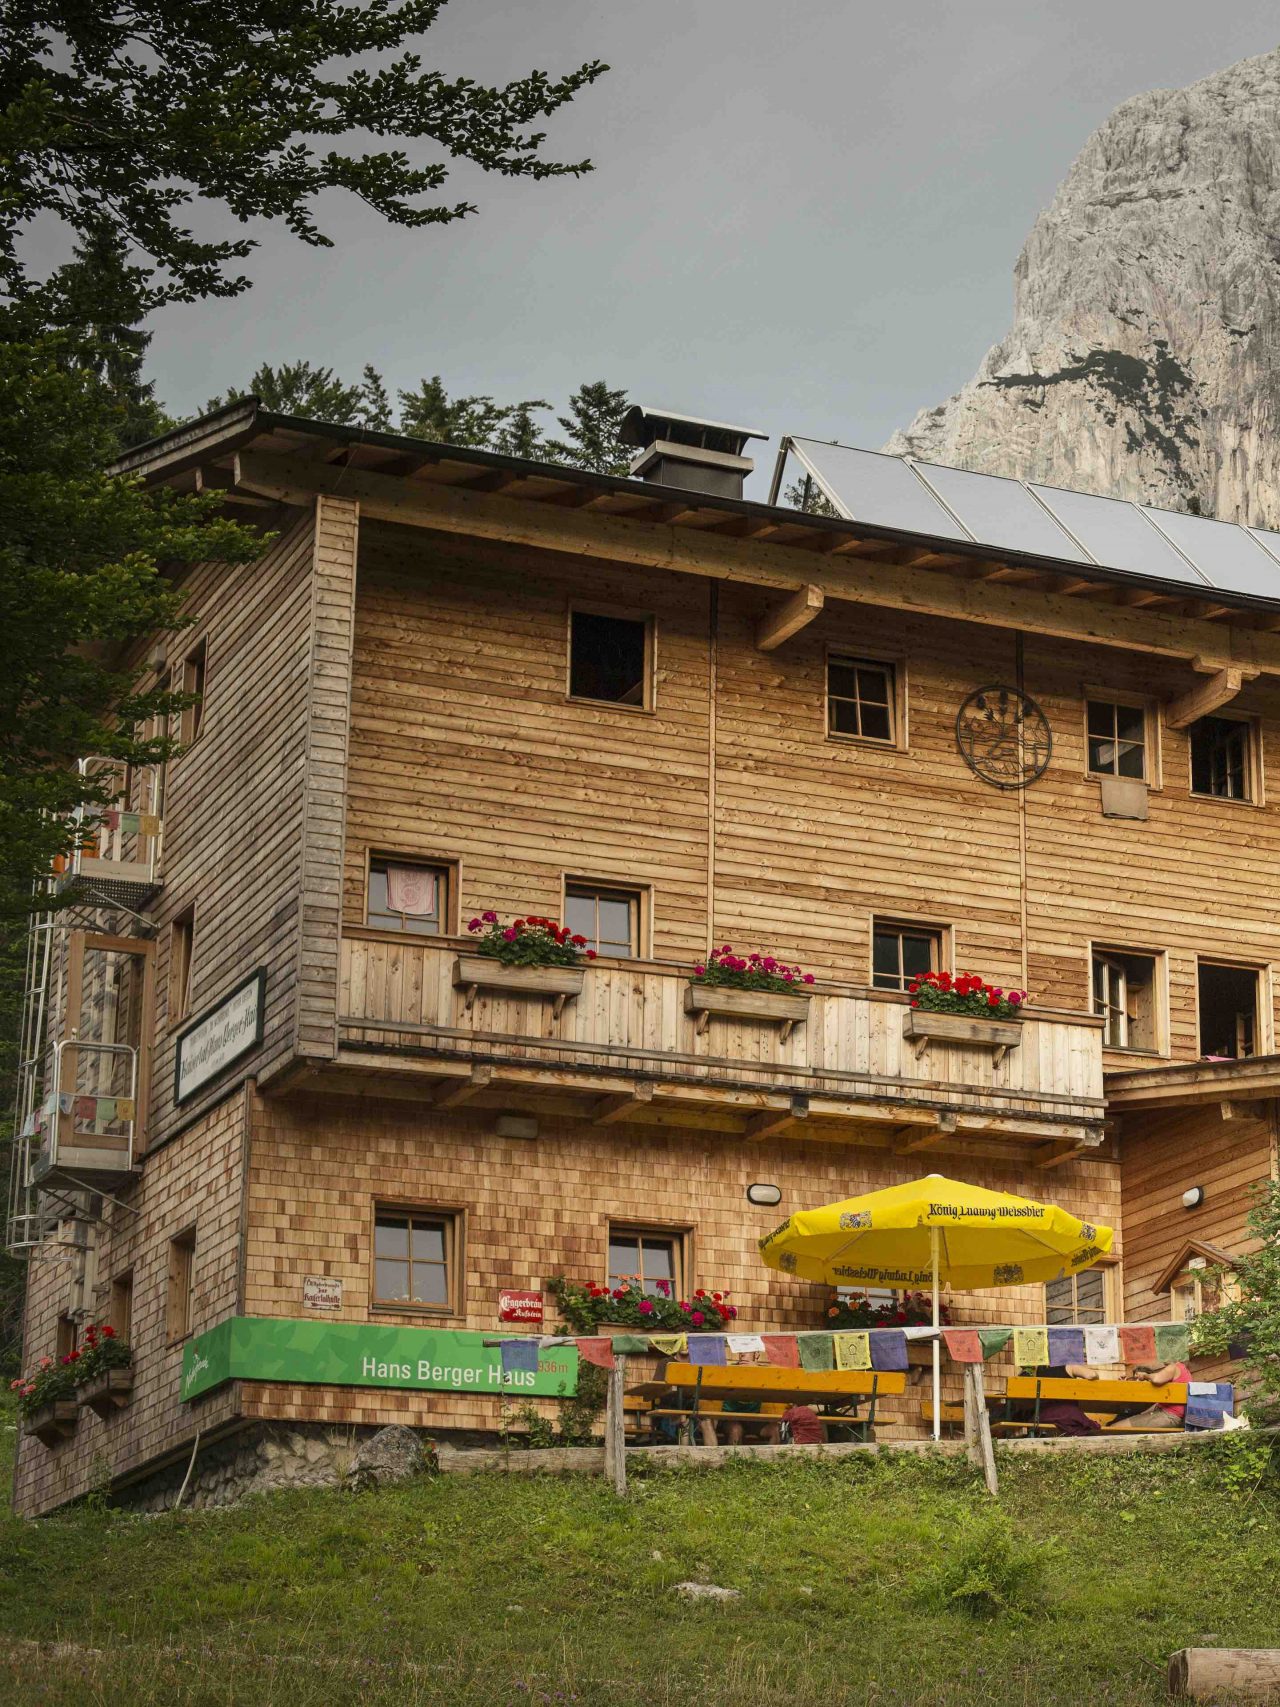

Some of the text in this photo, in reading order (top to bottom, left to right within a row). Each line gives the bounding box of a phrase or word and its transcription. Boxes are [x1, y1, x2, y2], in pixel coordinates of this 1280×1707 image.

[927, 1203, 958, 1220] König
[997, 1204, 1045, 1218] Weissbier
[362, 1357, 536, 1387] Hans Berger Haus
